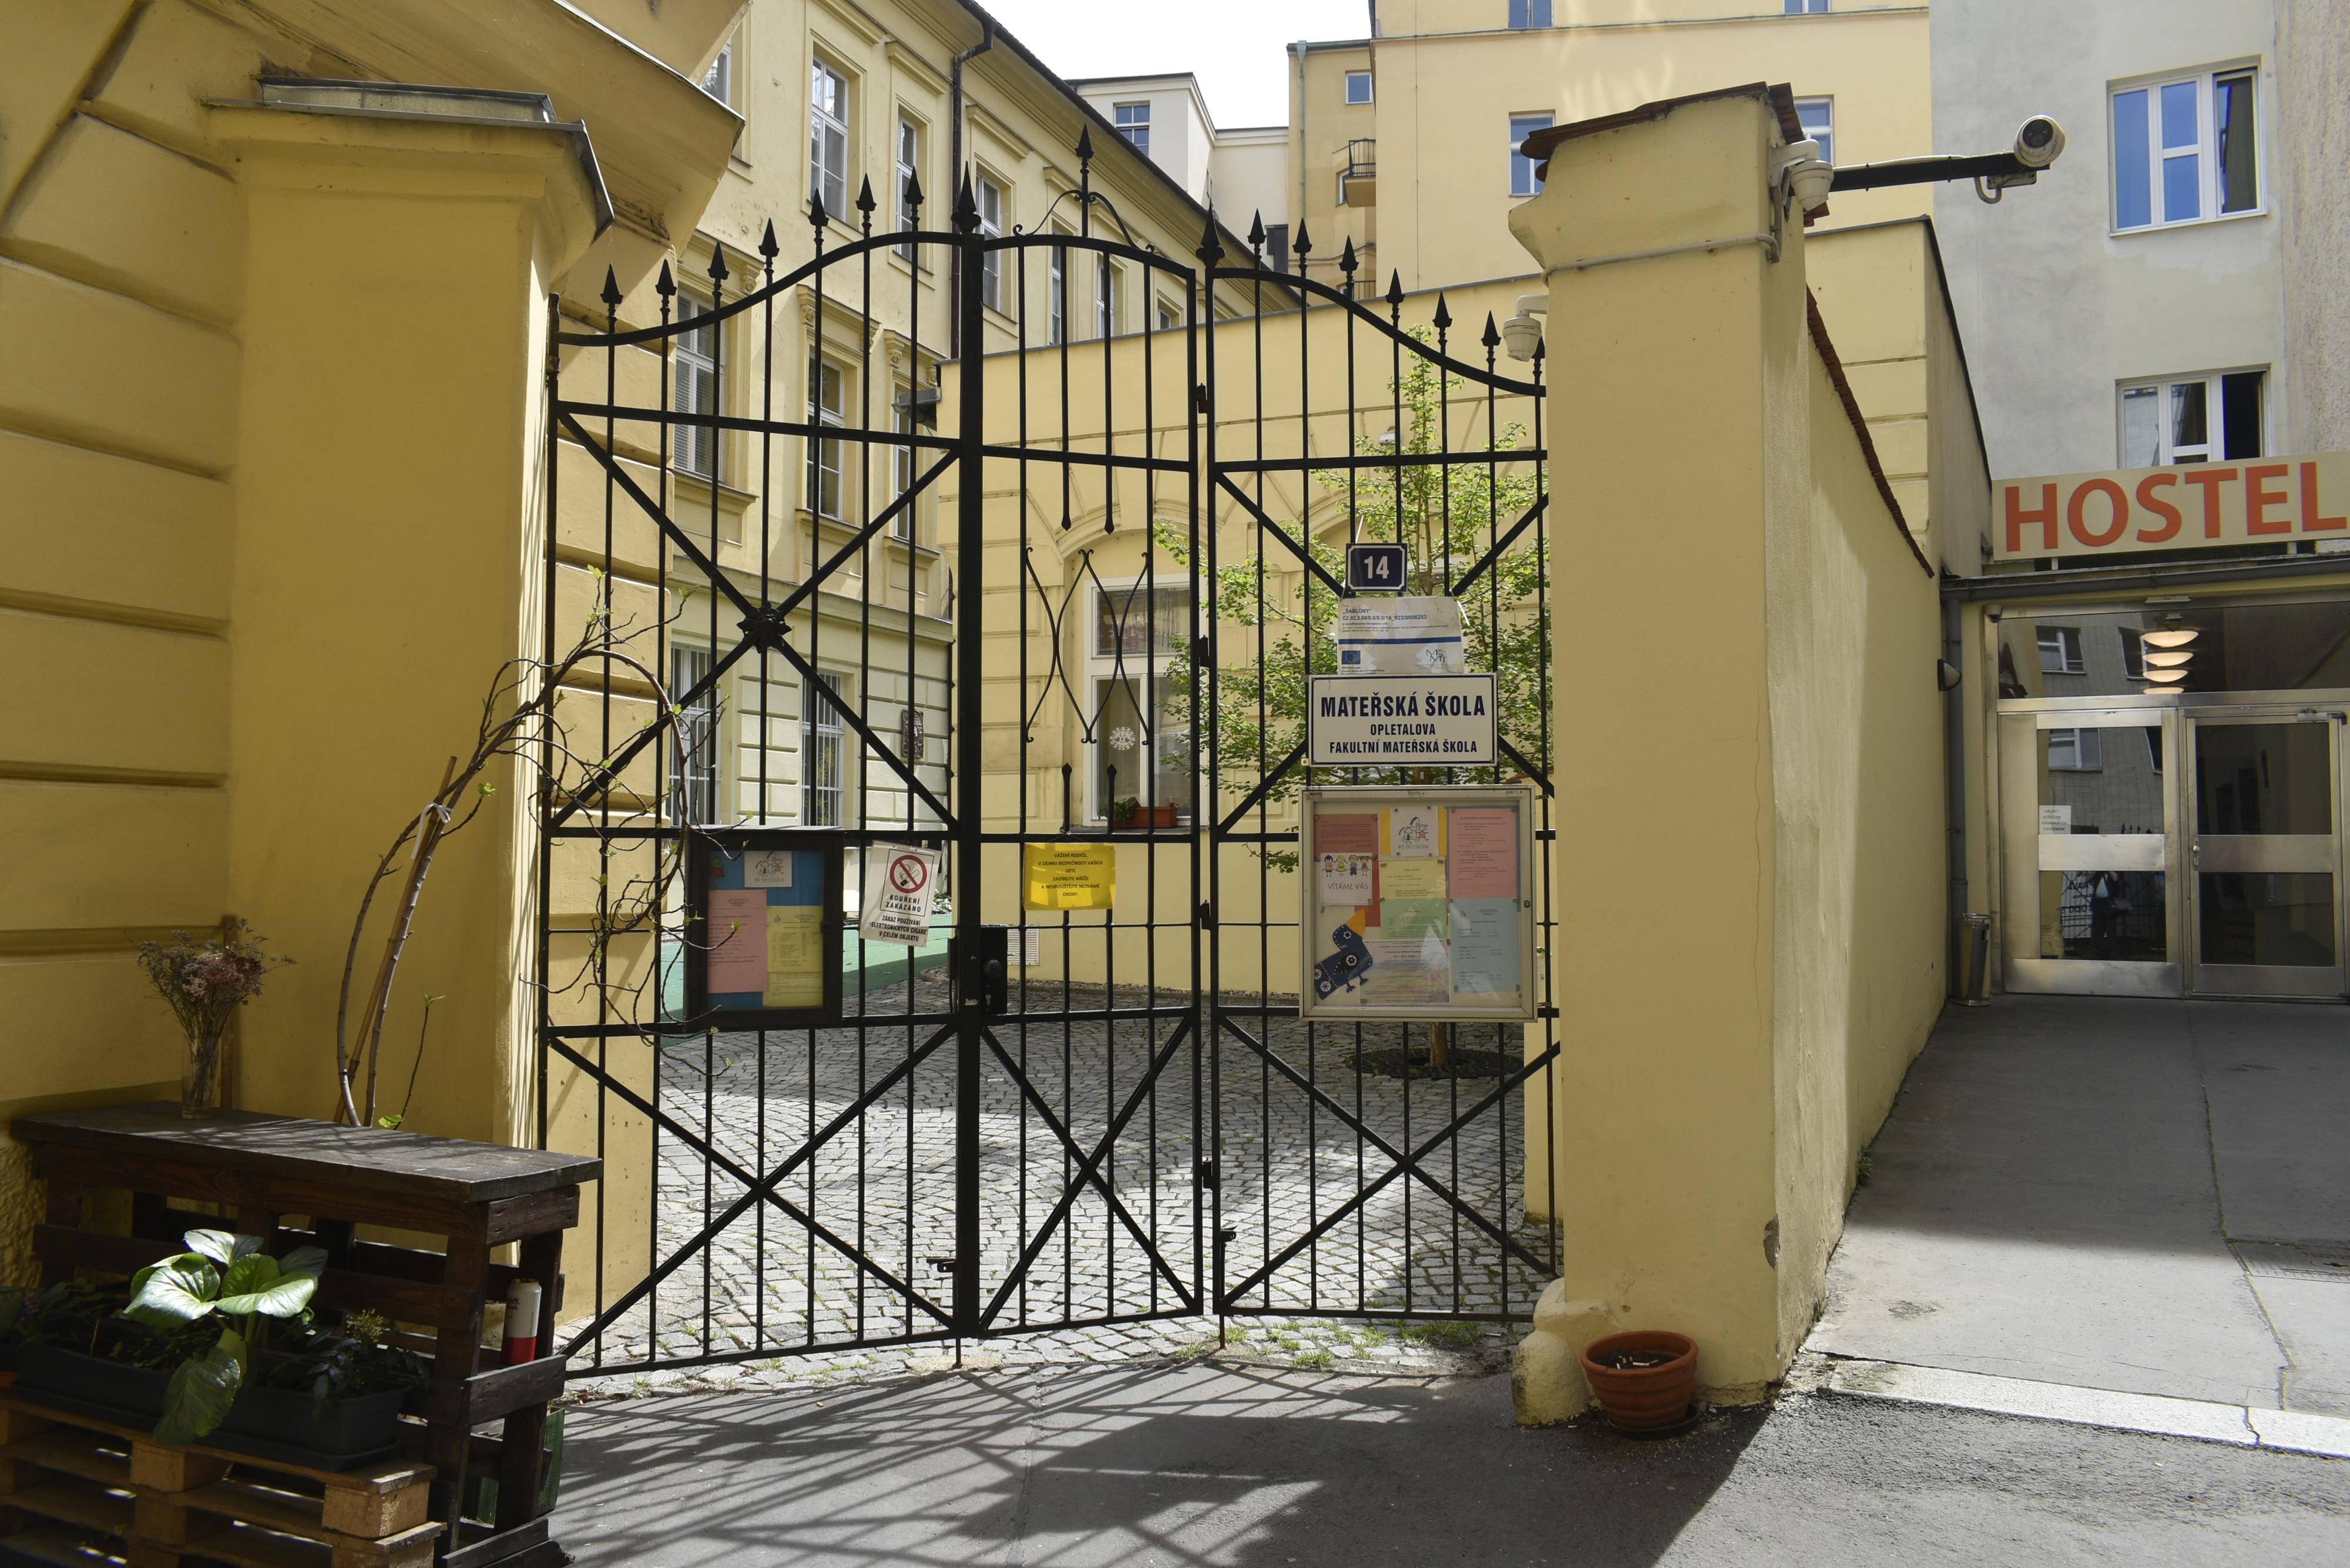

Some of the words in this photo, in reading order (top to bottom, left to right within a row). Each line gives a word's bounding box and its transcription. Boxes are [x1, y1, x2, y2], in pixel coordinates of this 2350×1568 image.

[2005, 461, 2347, 552] HOSTEL
[1364, 556, 1389, 579] 14
[1321, 692, 1418, 717] MATEŘSKÁ
[1425, 691, 1485, 716] ŠKOLA
[1370, 724, 1435, 735] OPLETALOVA
[1330, 739, 1379, 753] FAKULTNÍ
[1383, 738, 1441, 753] MATEŘSKÁ
[1443, 738, 1477, 753] ŠKOLA
[889, 894, 921, 904] KOUŘENÍ
[886, 902, 921, 912] ZAKÁZÁNO
[871, 921, 909, 932] ELEKTRONICKÝCH
[897, 916, 921, 926] POUŽÍVÁNÍ
[883, 931, 898, 939] CELÉM
[899, 934, 919, 942] OBJEKTU
